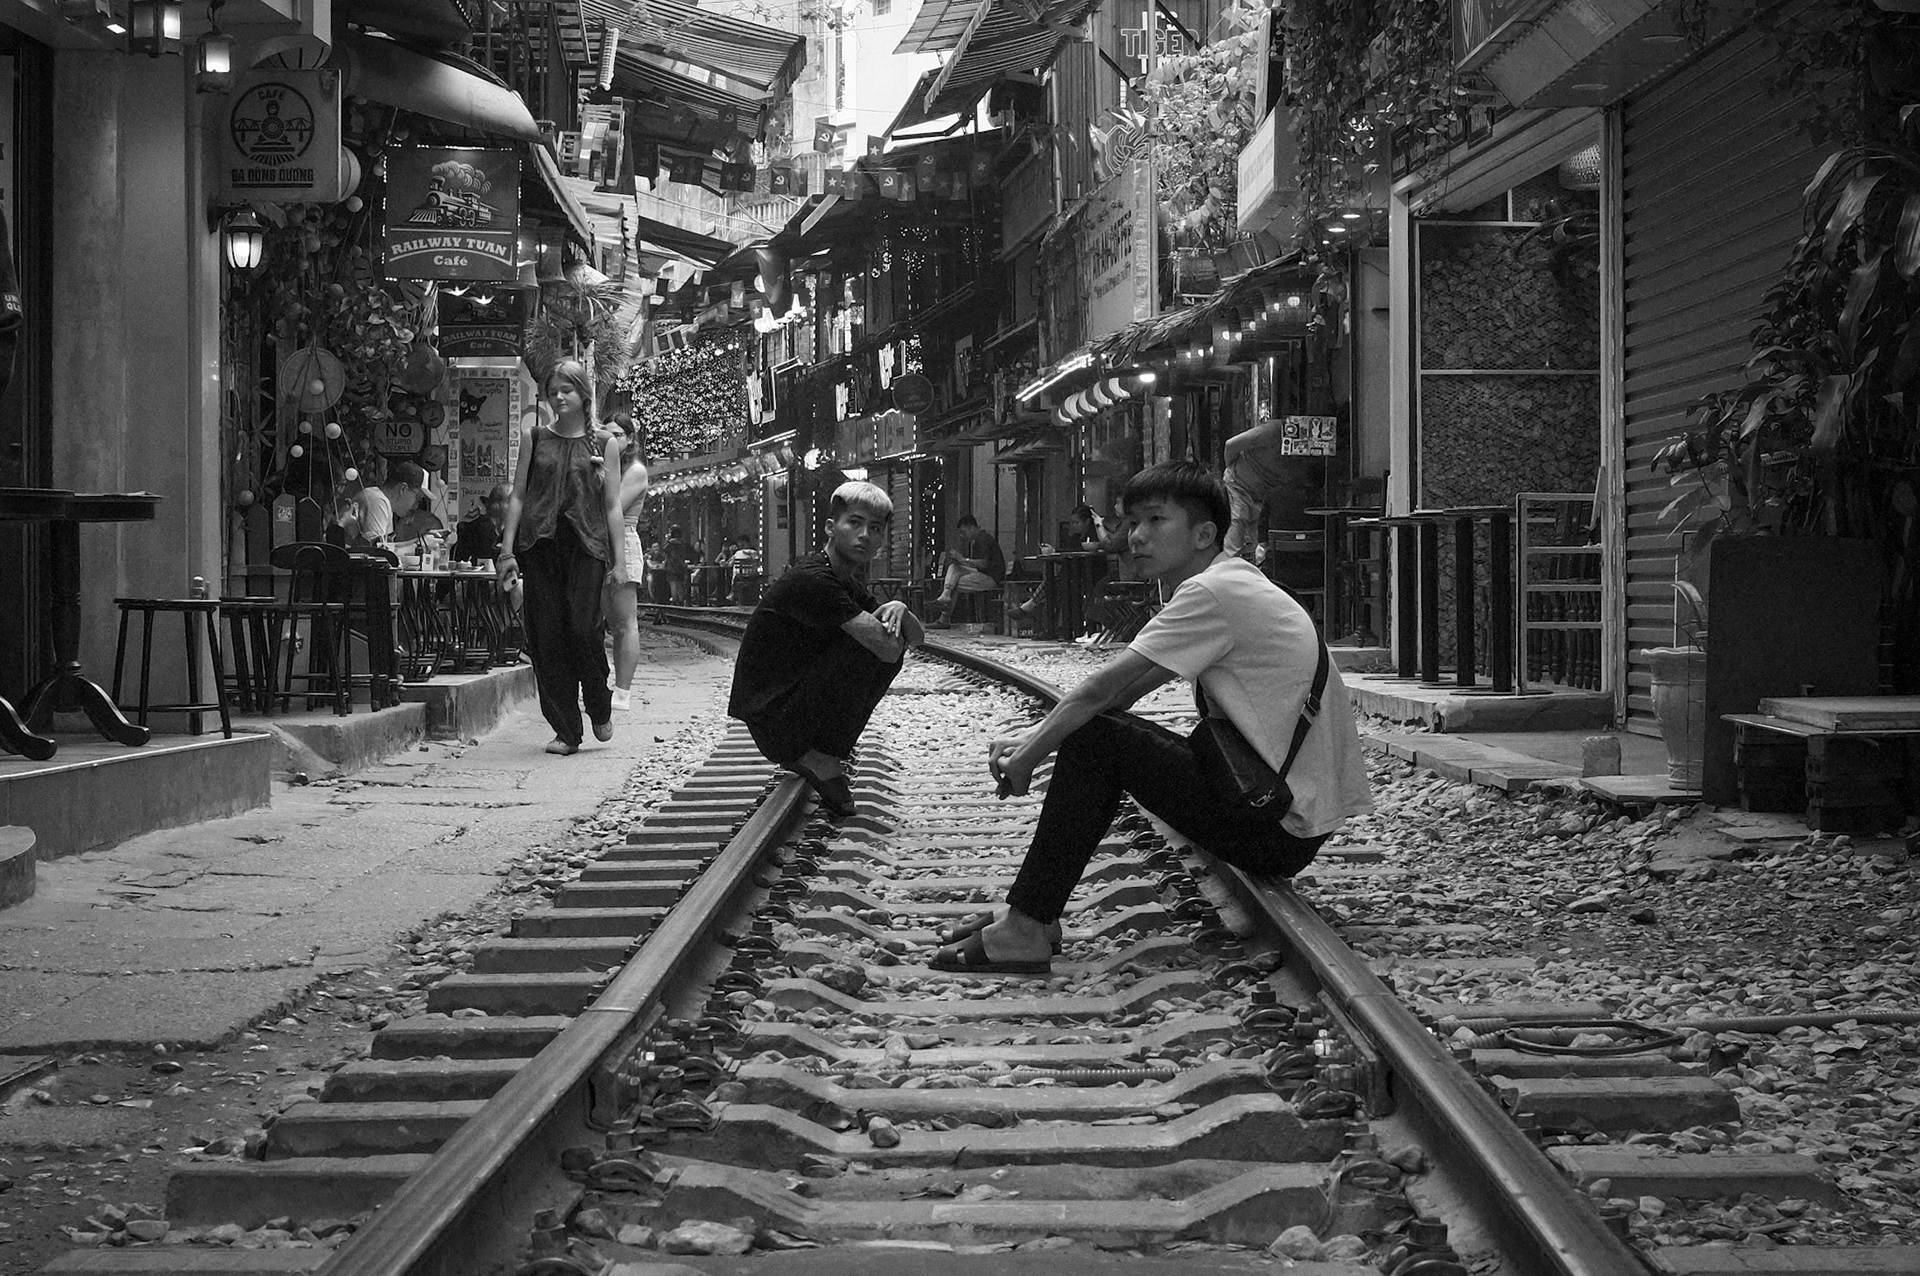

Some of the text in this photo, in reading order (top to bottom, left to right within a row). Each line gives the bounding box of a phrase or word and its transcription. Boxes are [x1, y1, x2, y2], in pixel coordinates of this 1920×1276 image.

[232, 169, 245, 182] GA
[391, 237, 507, 256] RAILWAY TUAN
[433, 255, 469, 266] Café
[442, 330, 517, 343] RAILWAY TUAN
[386, 423, 412, 438] NO
